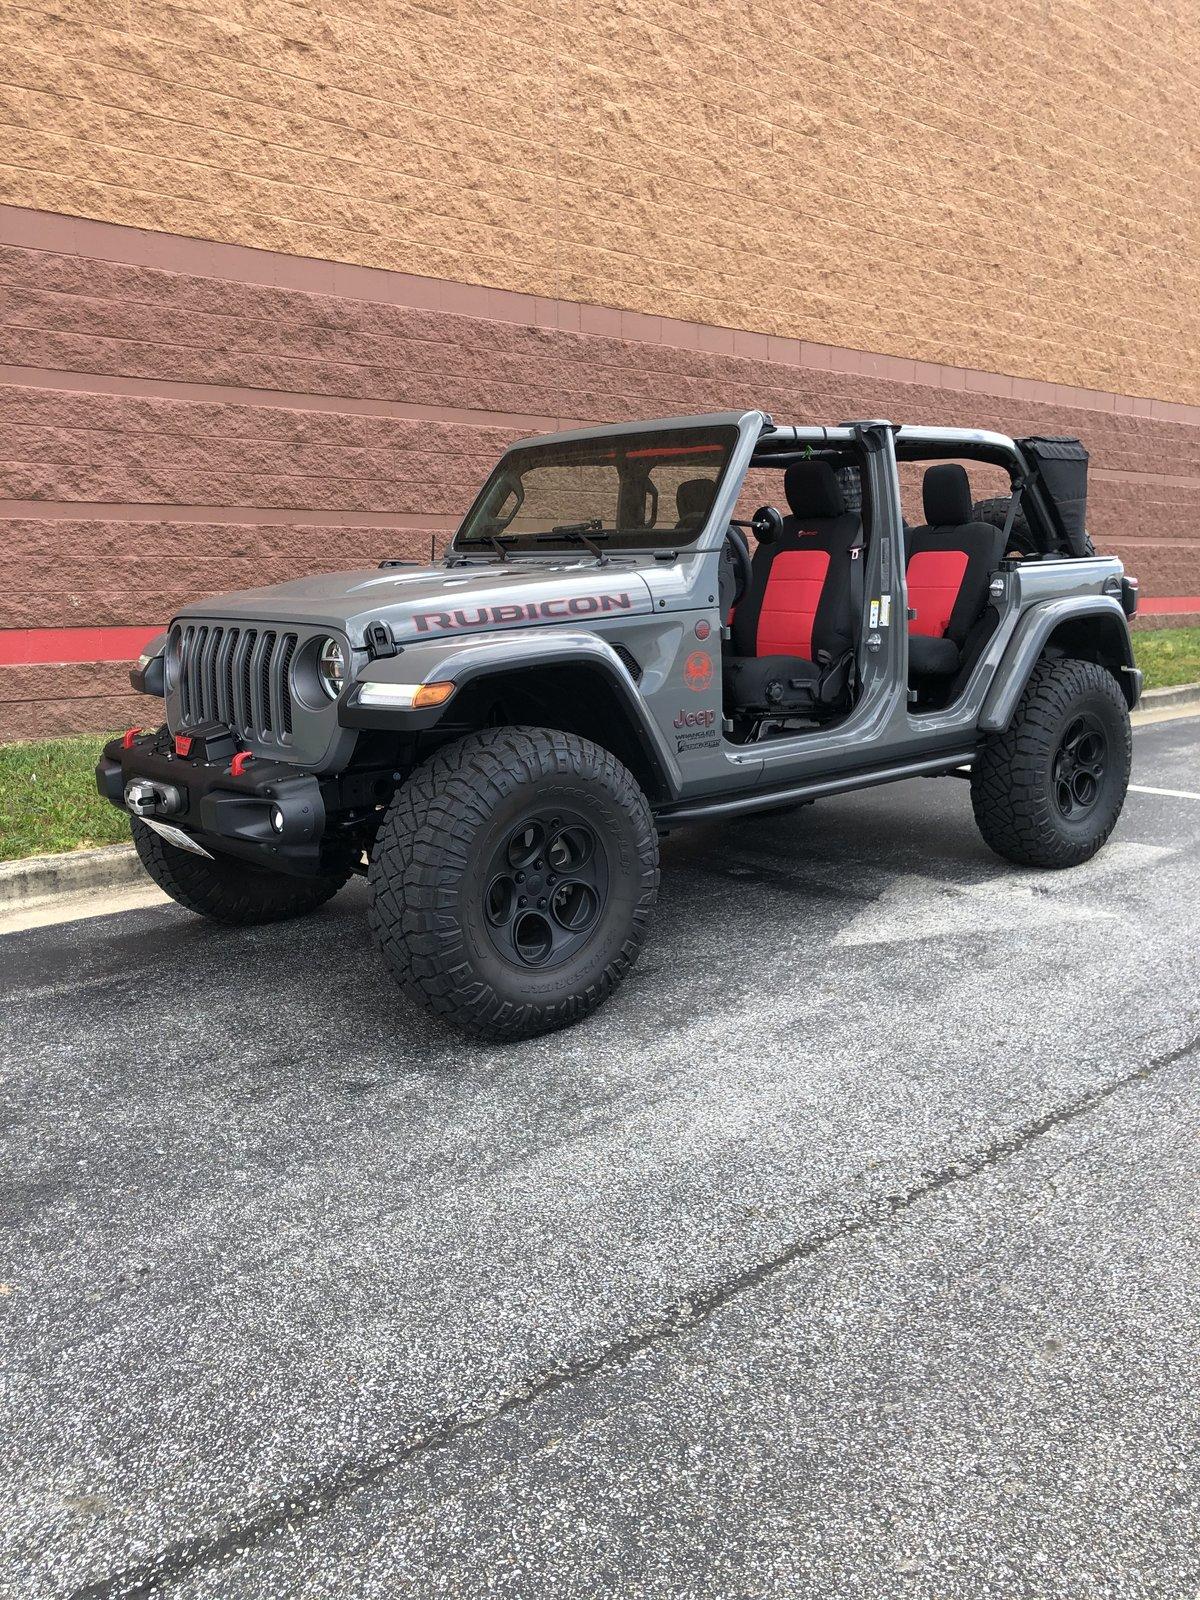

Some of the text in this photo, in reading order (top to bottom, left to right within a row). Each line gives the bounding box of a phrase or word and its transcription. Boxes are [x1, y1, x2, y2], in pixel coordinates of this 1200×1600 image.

[413, 593, 631, 632] RUBICON
[673, 709, 715, 728] Jeep
[675, 730, 715, 740] WRANGLER
